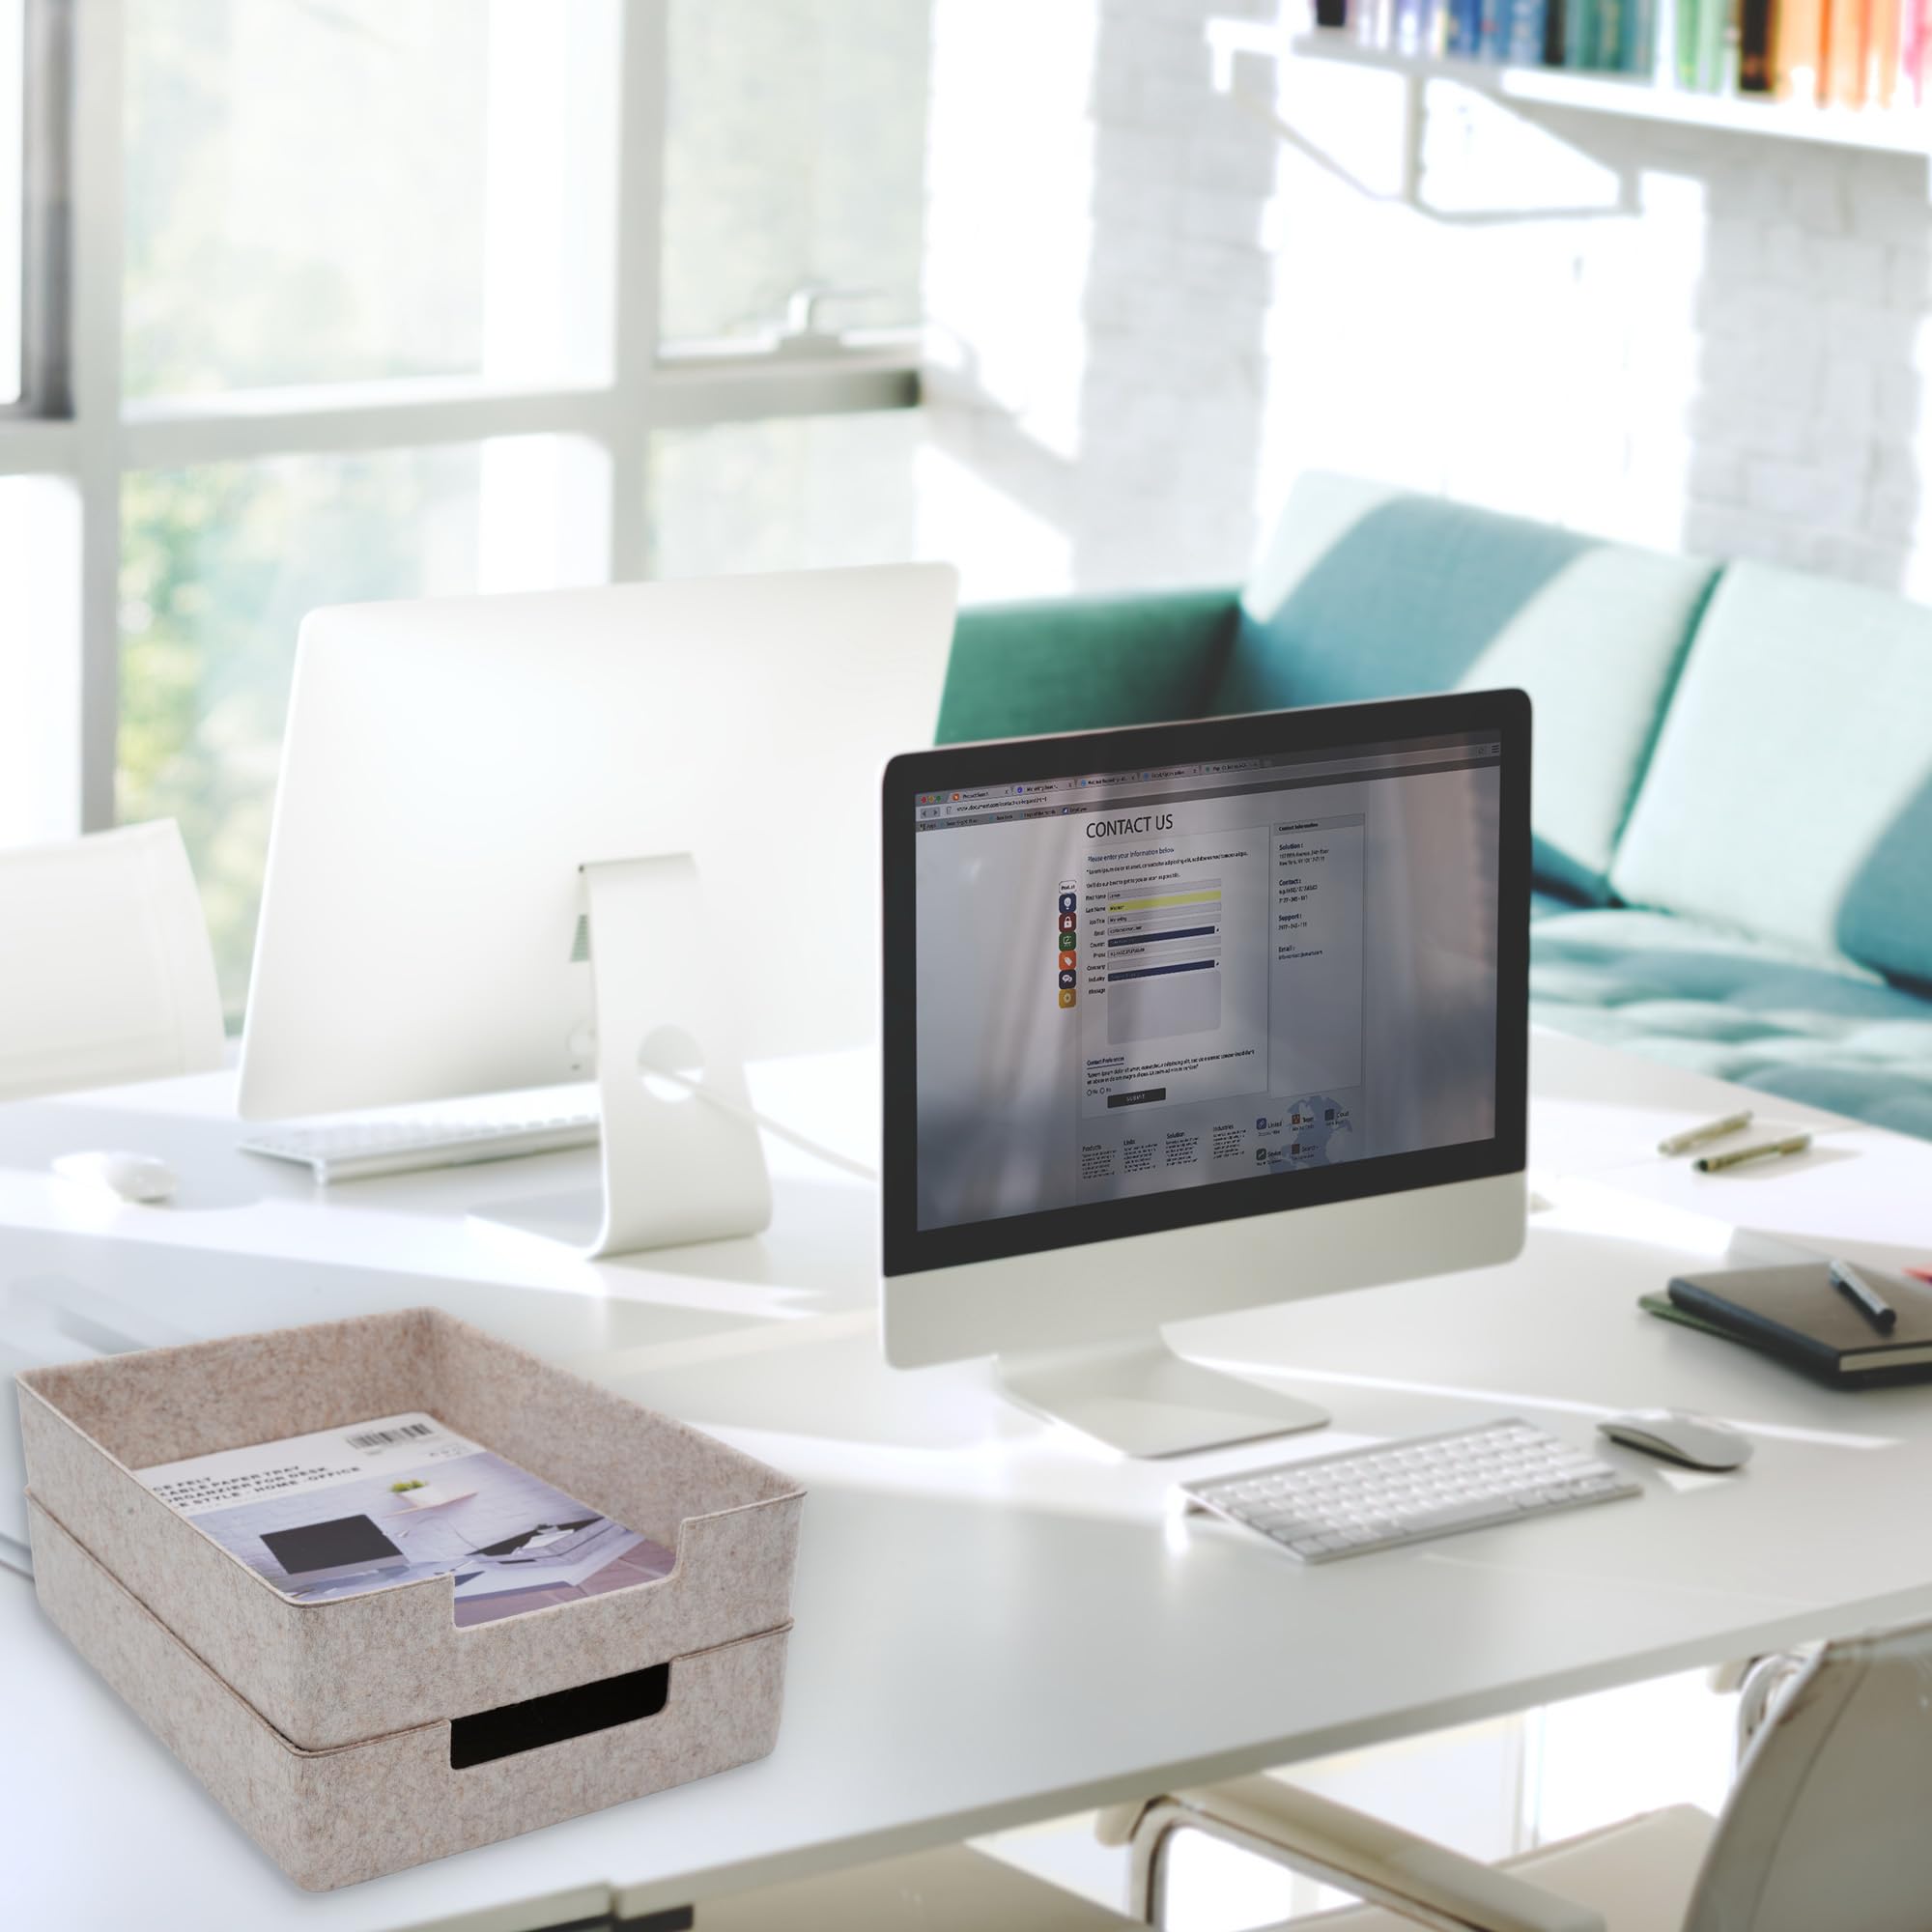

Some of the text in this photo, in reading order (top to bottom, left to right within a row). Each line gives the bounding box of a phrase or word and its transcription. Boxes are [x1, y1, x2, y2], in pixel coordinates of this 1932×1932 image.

[1086, 813, 1174, 838] CONTACT US
[177, 1476, 212, 1488] FELT
[211, 1473, 262, 1488] PAPER
[264, 1465, 299, 1477] TRAY
[255, 1474, 286, 1486] FOR
[288, 1466, 327, 1479] DESK
[192, 1492, 241, 1505] STYLE
[254, 1480, 298, 1492] HOME
